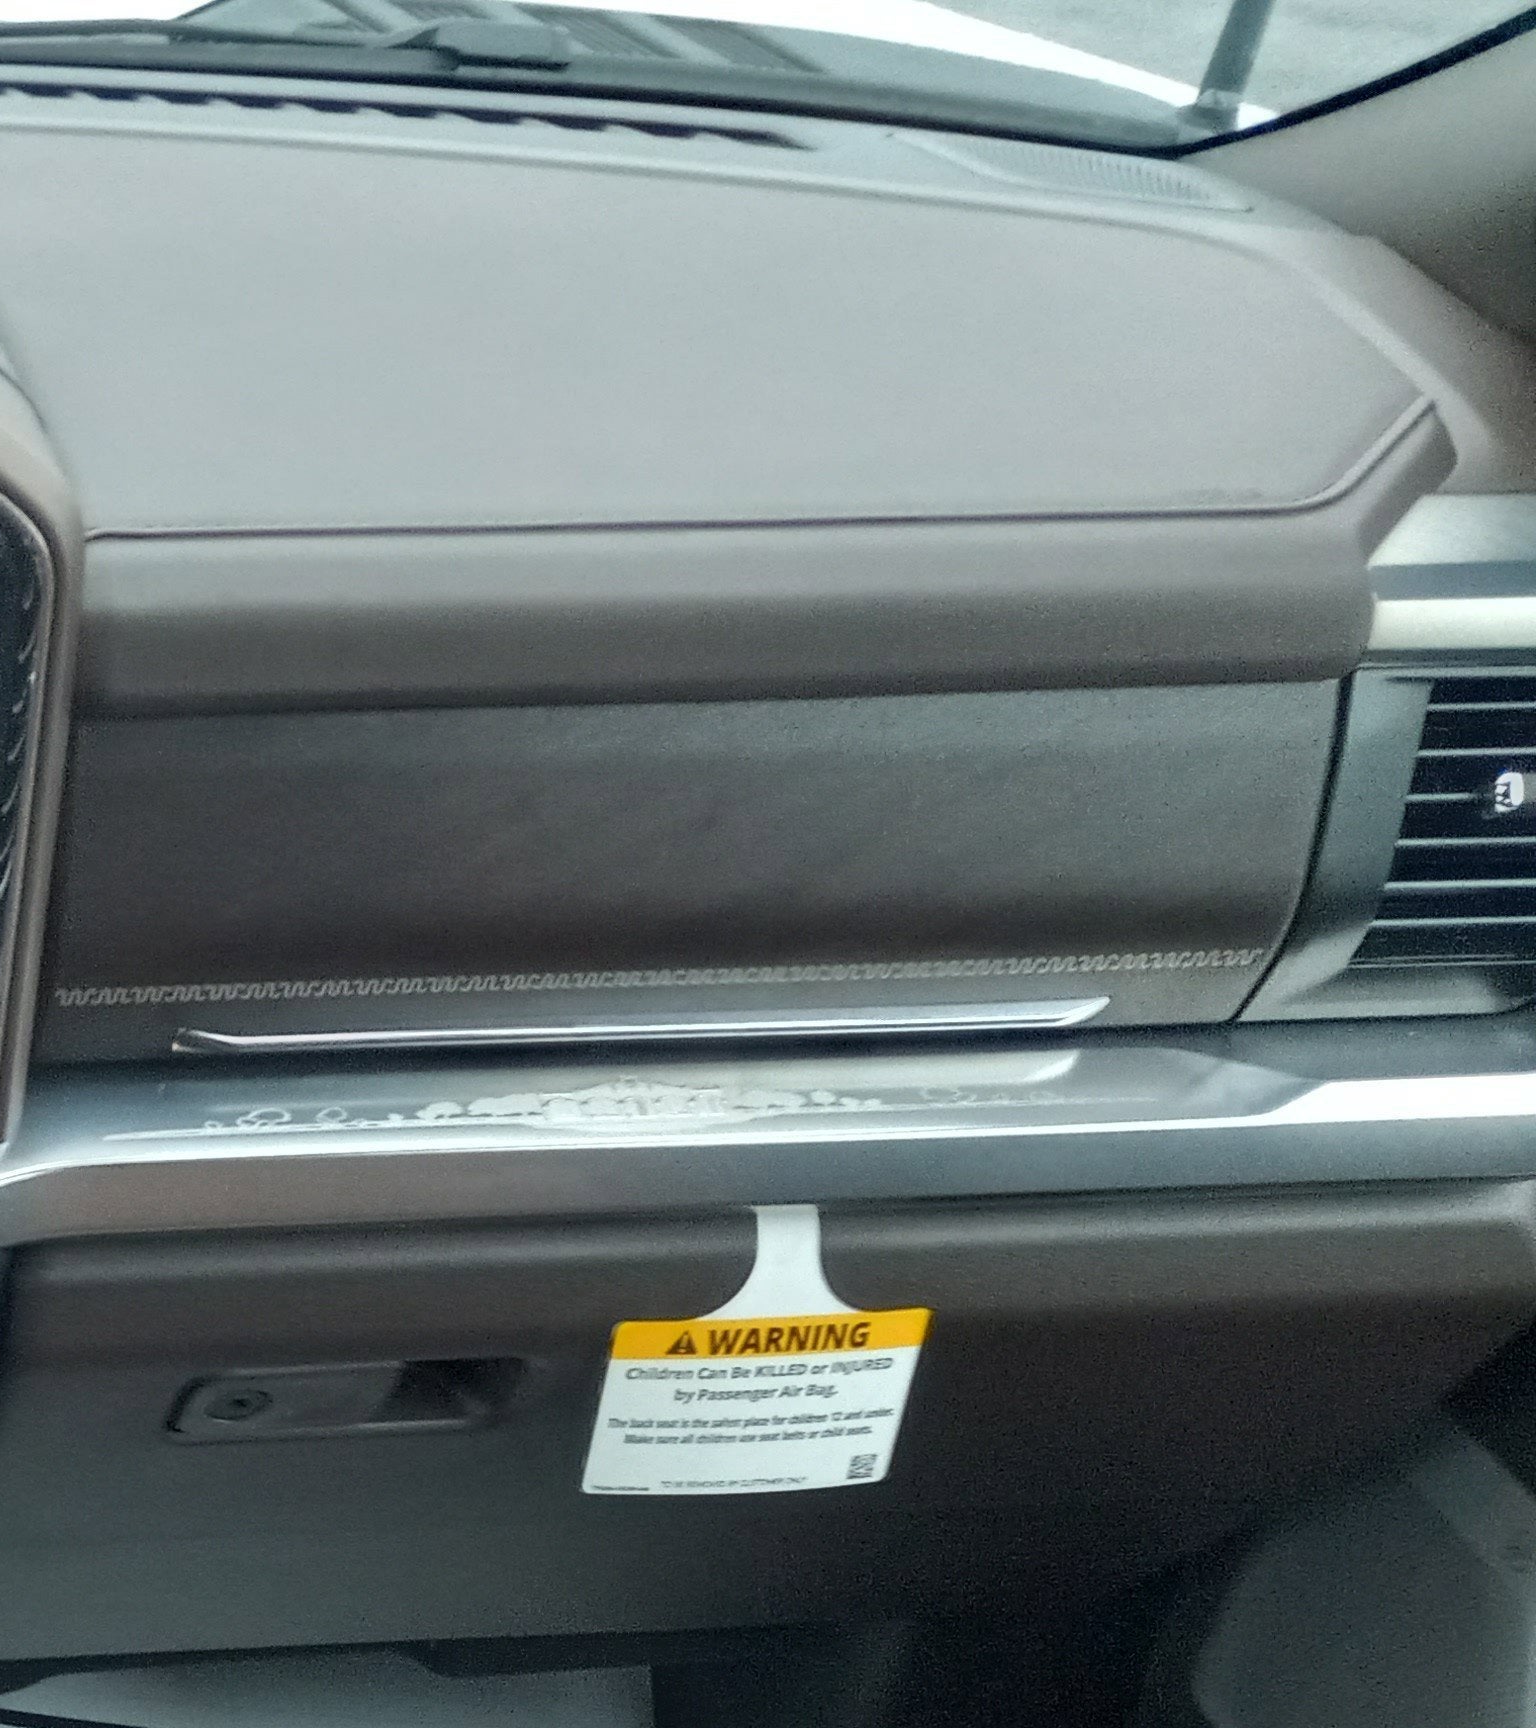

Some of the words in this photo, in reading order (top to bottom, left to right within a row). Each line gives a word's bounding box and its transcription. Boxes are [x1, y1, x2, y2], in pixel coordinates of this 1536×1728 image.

[709, 1321, 871, 1355] WARNING
[625, 1366, 695, 1380] Children
[697, 1366, 726, 1380] Can
[730, 1366, 750, 1379] Be
[754, 1363, 808, 1378] KILLED
[811, 1364, 829, 1376] or
[830, 1357, 894, 1376] INJURED
[674, 1388, 695, 1404] by
[697, 1388, 778, 1403] Passenger
[779, 1385, 804, 1398] Air
[805, 1383, 839, 1399] Bag.
[608, 1416, 628, 1428] The
[655, 1418, 678, 1429] seat
[743, 1417, 769, 1430] place
[788, 1413, 828, 1425] children
[843, 1410, 863, 1420] and
[696, 1434, 736, 1444] children
